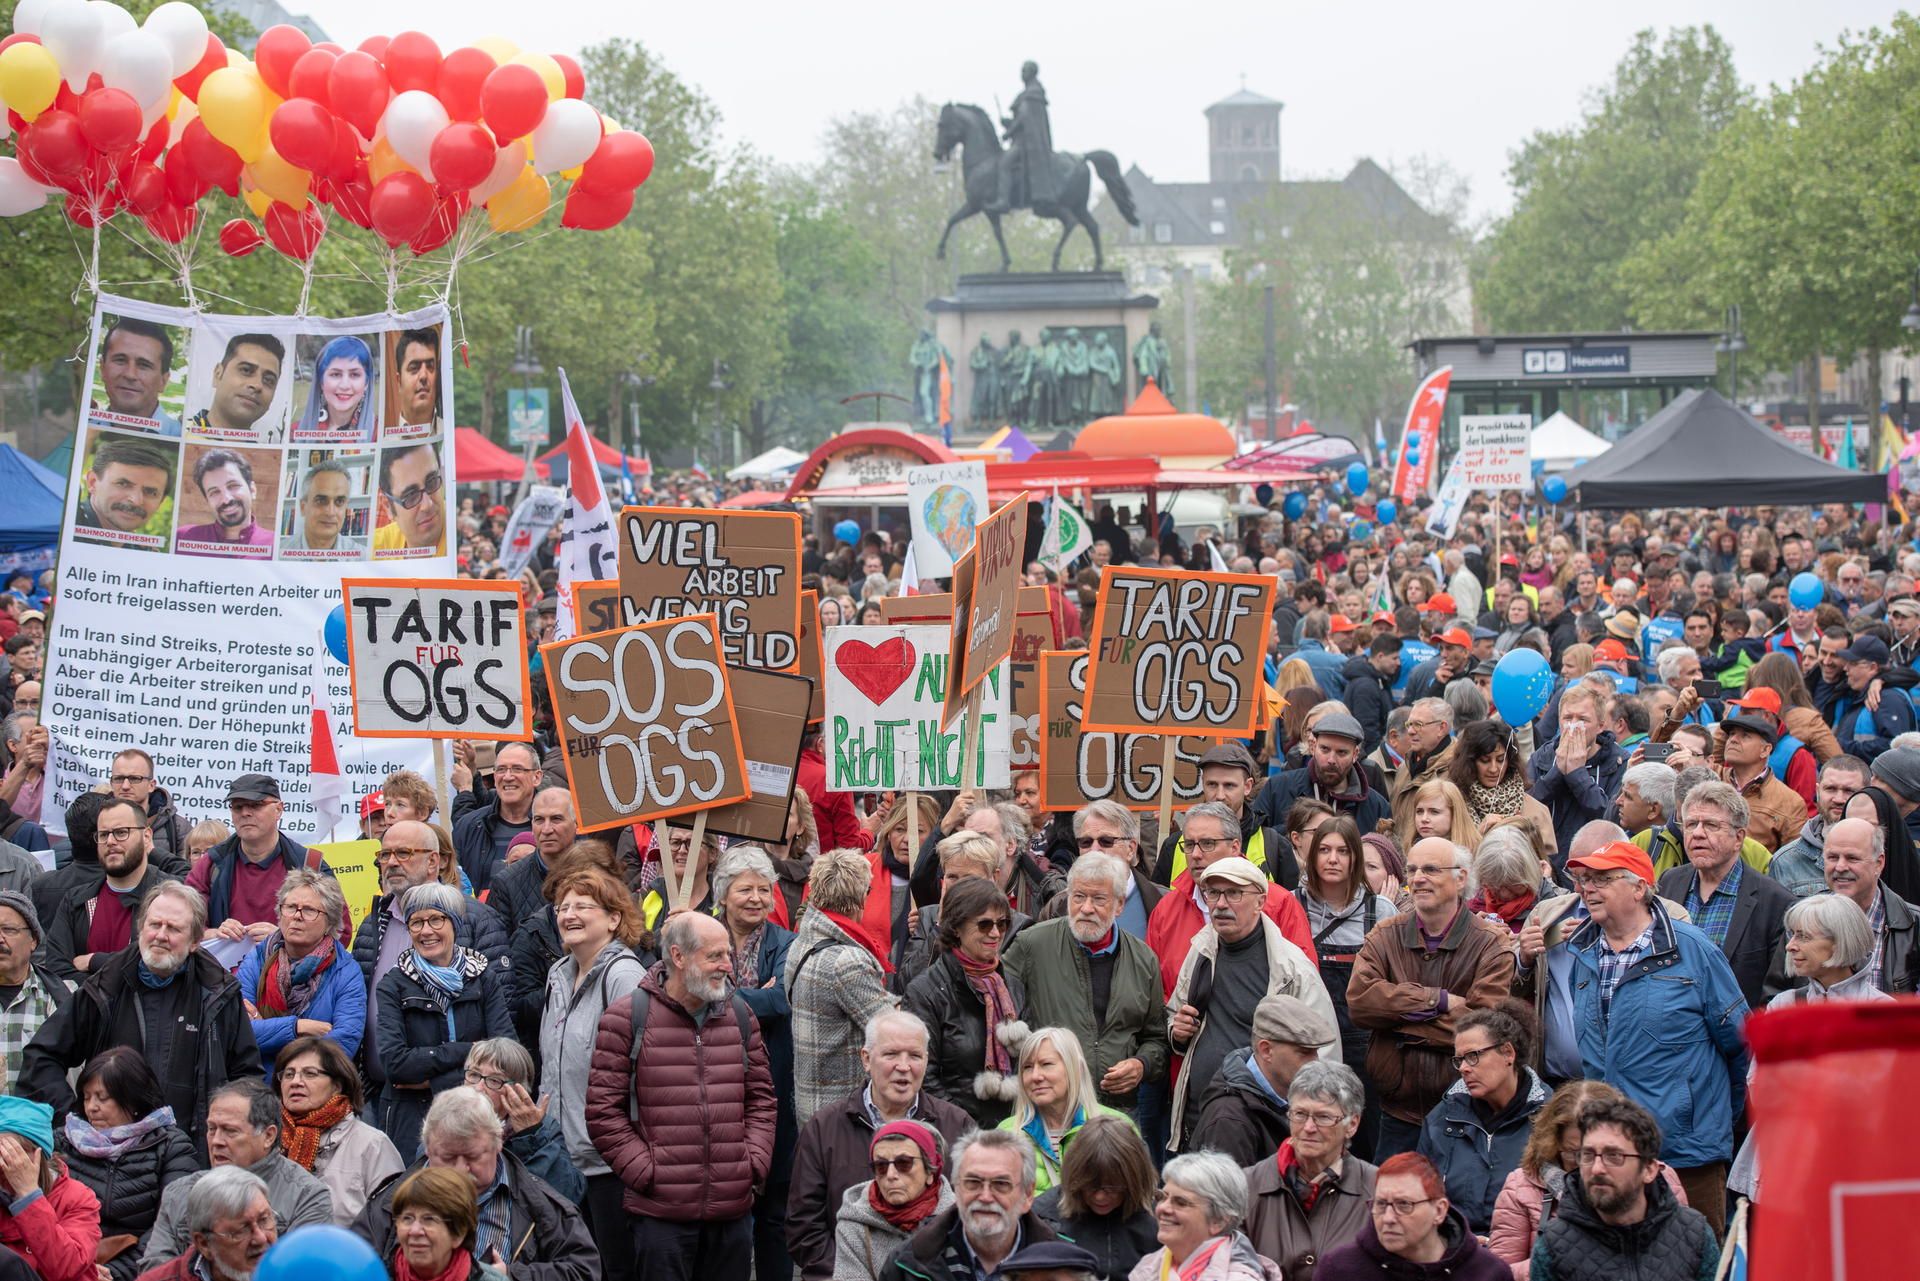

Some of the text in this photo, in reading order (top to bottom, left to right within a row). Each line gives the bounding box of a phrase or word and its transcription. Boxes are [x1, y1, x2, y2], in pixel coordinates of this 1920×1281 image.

[1572, 354, 1625, 367] Heumarkt
[89, 411, 160, 428] JAFAR AZIMZADEH
[191, 428, 260, 438] ESMAIL BAKHSHI
[386, 427, 408, 435] ESMAIL
[1465, 448, 1484, 456] und
[1466, 435, 1479, 446] der
[1465, 457, 1509, 467] auf der
[1466, 470, 1521, 483] Terrasse
[75, 528, 159, 544] MAHMOOD BEHESHTI
[179, 542, 268, 554] ROUHOLLAH MARDANI
[627, 516, 729, 567] VIEL
[981, 511, 1016, 586] VIRUS
[66, 566, 342, 599] Alle im Iran inhaftierten Arbeiter un
[682, 565, 785, 597] ARBEIT
[64, 588, 283, 617] sofort freigelassen werden.
[1112, 578, 1263, 642] TARIF
[352, 597, 518, 646] TARIF
[60, 624, 79, 640] Im
[84, 627, 115, 643] Iran
[121, 633, 156, 648] sind
[161, 636, 222, 655] Streiks,
[228, 640, 292, 656] Proteste
[721, 632, 798, 669] ELD
[1099, 636, 1137, 664] FÜR
[58, 647, 172, 670] unabhängiger
[416, 643, 463, 667] FÜR
[56, 664, 95, 681] Aber
[100, 670, 124, 683] die
[129, 672, 196, 690] Arbeiter
[200, 679, 263, 694] streiken
[269, 683, 297, 695] und
[560, 621, 725, 734] SOS
[1134, 639, 1244, 724] OGS
[54, 683, 110, 702] überall
[116, 690, 134, 704] im
[141, 693, 181, 708] Land
[187, 698, 217, 711] und
[222, 701, 286, 715] gründen
[383, 659, 516, 729] OGS
[52, 702, 183, 727] Organisationen.
[189, 715, 216, 730] Der
[221, 718, 305, 736] Höhepunkt
[1048, 718, 1073, 738] FÜR
[50, 724, 80, 738] seit
[85, 727, 134, 744] einem
[139, 732, 176, 747] Jahr
[181, 737, 229, 751] waren
[235, 739, 257, 752] die
[567, 736, 602, 758] FÜR
[208, 760, 236, 770] von
[241, 758, 273, 772] Haft
[278, 760, 312, 775] Tapp
[345, 762, 376, 774] owie
[599, 717, 725, 814] OGS
[1077, 732, 1204, 801] OGS
[158, 776, 187, 787] von
[192, 775, 232, 789] Ahva
[53, 793, 71, 809] für
[279, 819, 316, 832] Lebe
